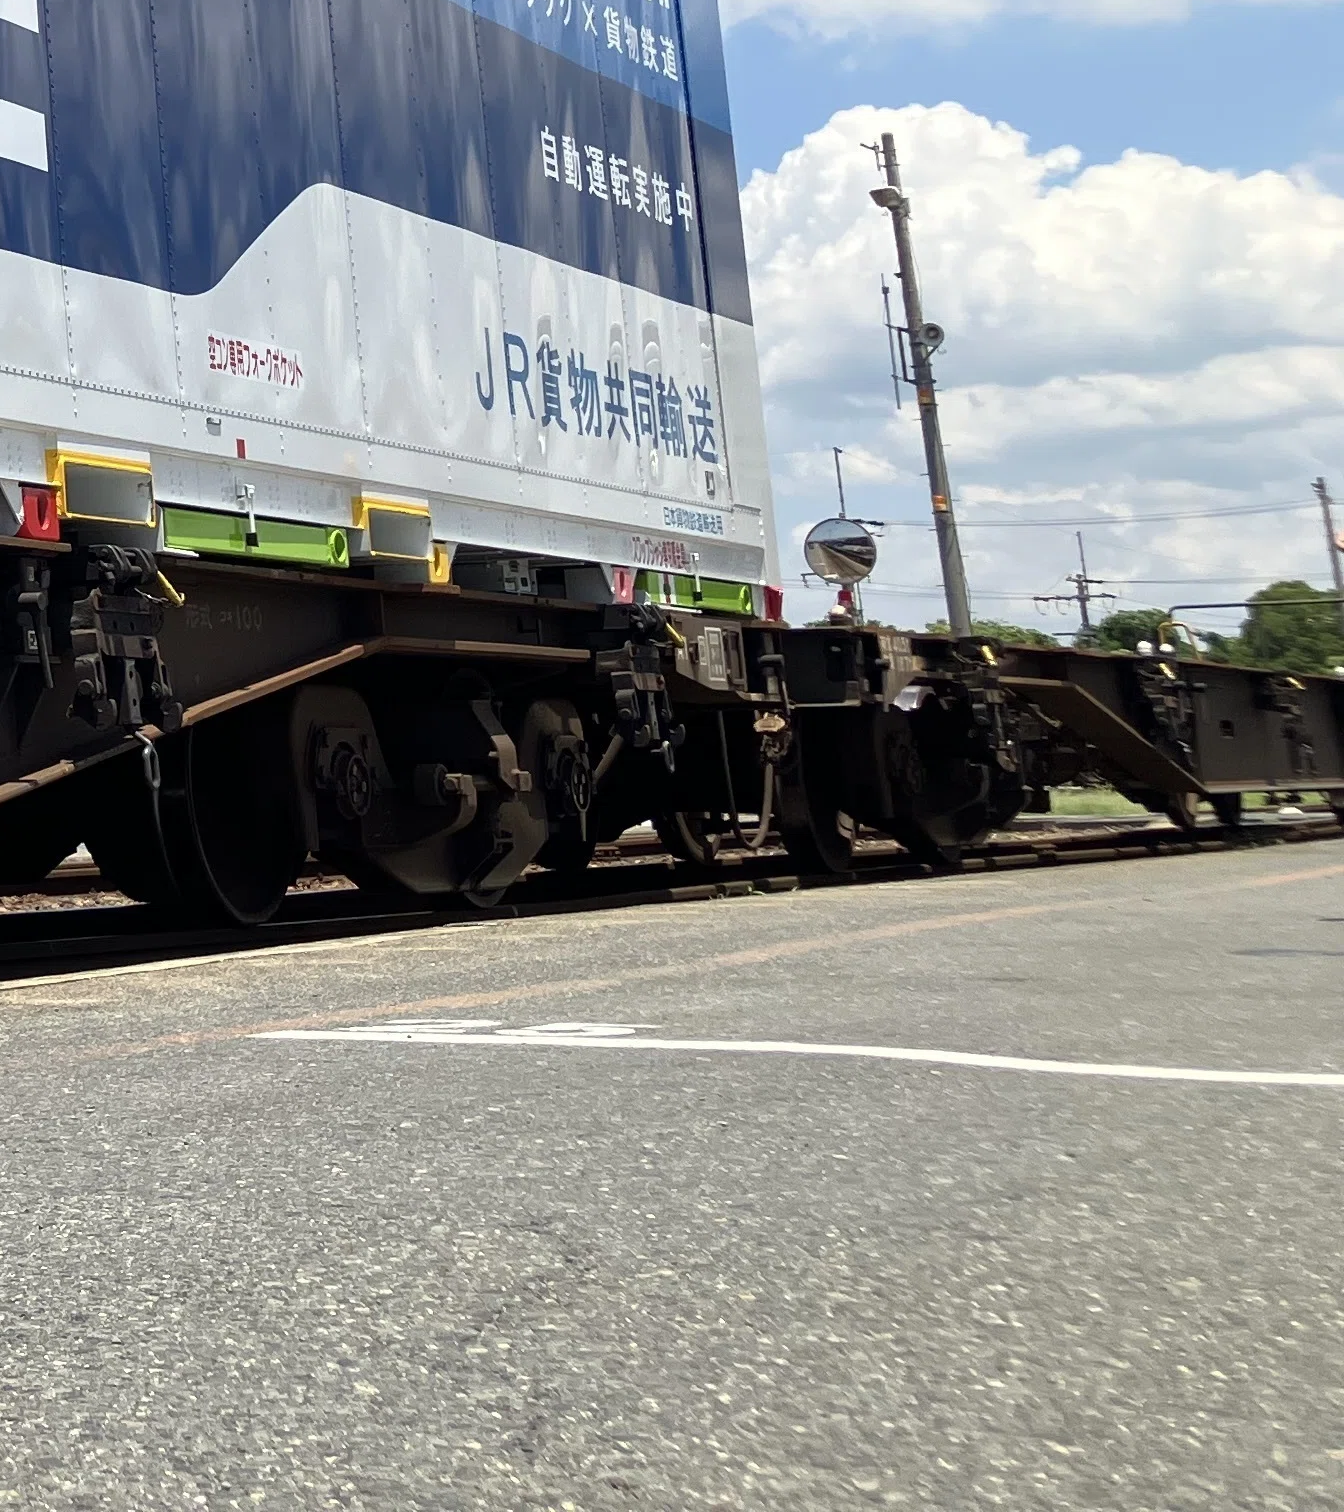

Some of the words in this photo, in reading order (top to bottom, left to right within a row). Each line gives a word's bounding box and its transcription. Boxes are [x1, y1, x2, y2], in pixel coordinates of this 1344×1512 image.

[603, 5, 678, 82] 貨物鉄道
[540, 126, 694, 232] 自動運転実施中
[475, 327, 719, 465] JR貨物共同輸送
